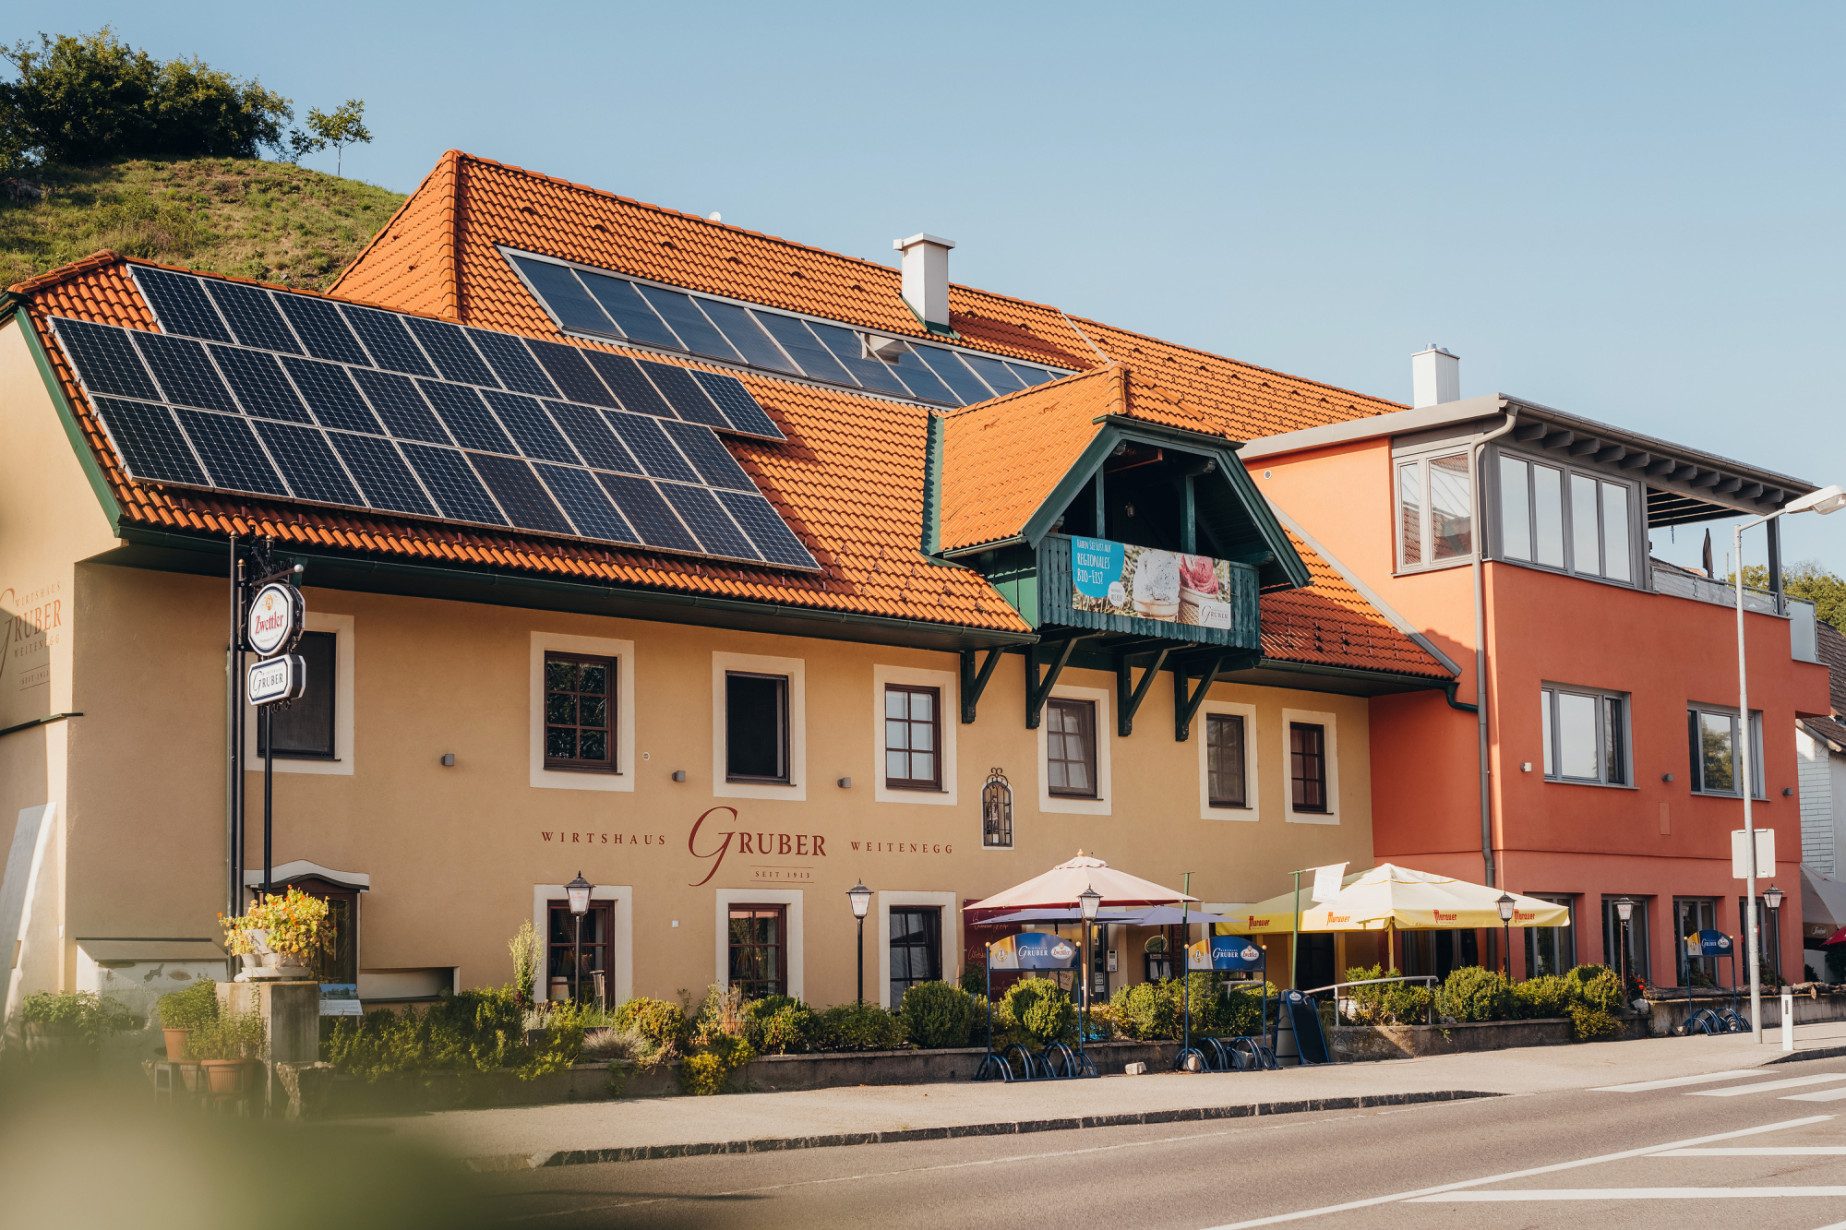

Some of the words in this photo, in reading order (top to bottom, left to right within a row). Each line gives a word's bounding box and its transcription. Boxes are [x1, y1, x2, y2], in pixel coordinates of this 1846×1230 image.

[1077, 552, 1110, 570] REGIONALES
[255, 611, 284, 635] Zwettler
[253, 670, 284, 698] GRUBER
[541, 831, 666, 845] WIRTSHAUS
[688, 806, 827, 887] GRUBER
[851, 841, 953, 854] WEITENEGG
[755, 870, 780, 878] SEIT
[786, 871, 811, 879] 1913
[1018, 945, 1049, 960] GRUBER
[1212, 947, 1238, 961] GRUBER
